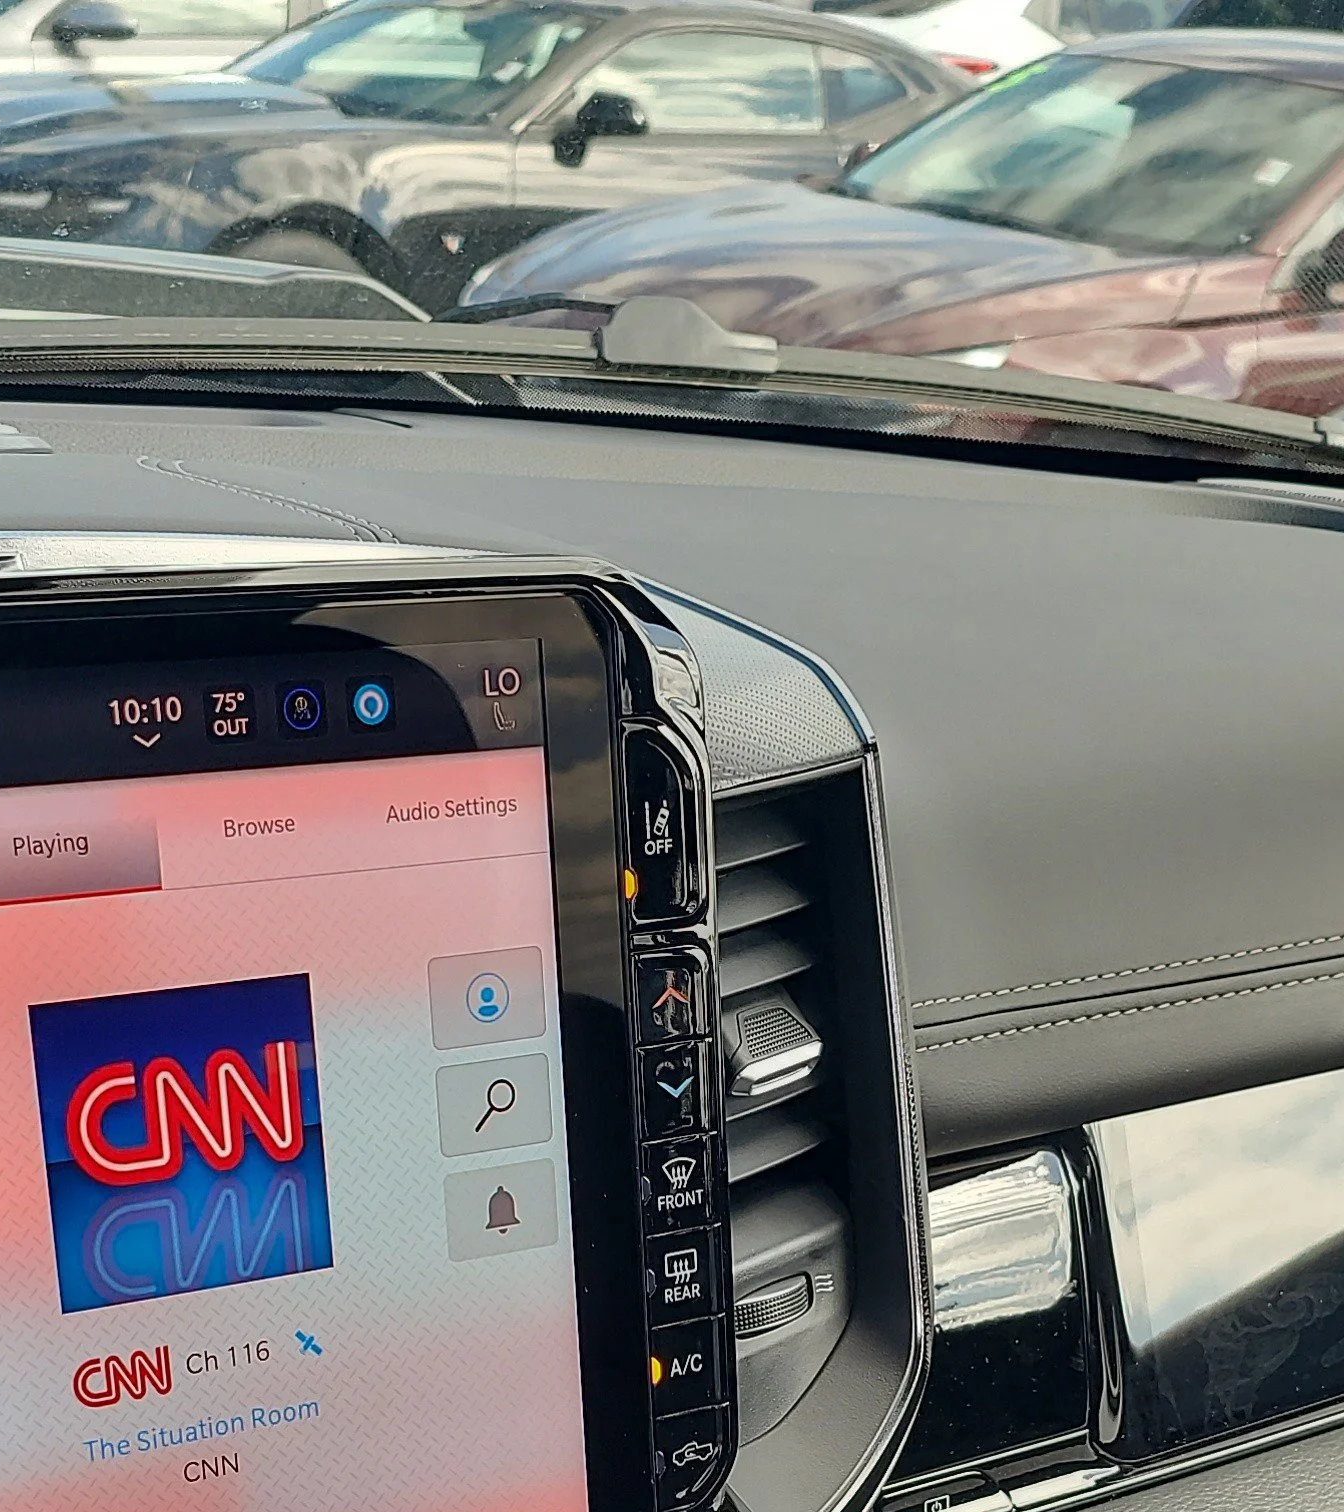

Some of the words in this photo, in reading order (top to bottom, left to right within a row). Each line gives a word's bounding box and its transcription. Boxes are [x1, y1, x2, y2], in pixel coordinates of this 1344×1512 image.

[482, 666, 523, 698] LO
[108, 695, 183, 726] 10:10
[211, 691, 246, 714] 75°
[213, 717, 250, 737] OUT
[385, 801, 440, 824] Audio
[444, 796, 519, 820] Settings
[223, 817, 297, 839] Browse
[12, 832, 91, 859] Playing
[644, 838, 674, 856] OFF
[66, 1040, 304, 1186] CNN
[657, 1189, 705, 1212] FRONT
[663, 1284, 702, 1304] REAR
[72, 1344, 173, 1408] CNN
[185, 1351, 219, 1375] Ch
[228, 1340, 271, 1368] 116
[669, 1353, 704, 1378] A/C
[83, 1437, 131, 1463] The
[136, 1413, 245, 1452] Situation
[251, 1400, 320, 1430] Room
[183, 1452, 240, 1483] CNN
